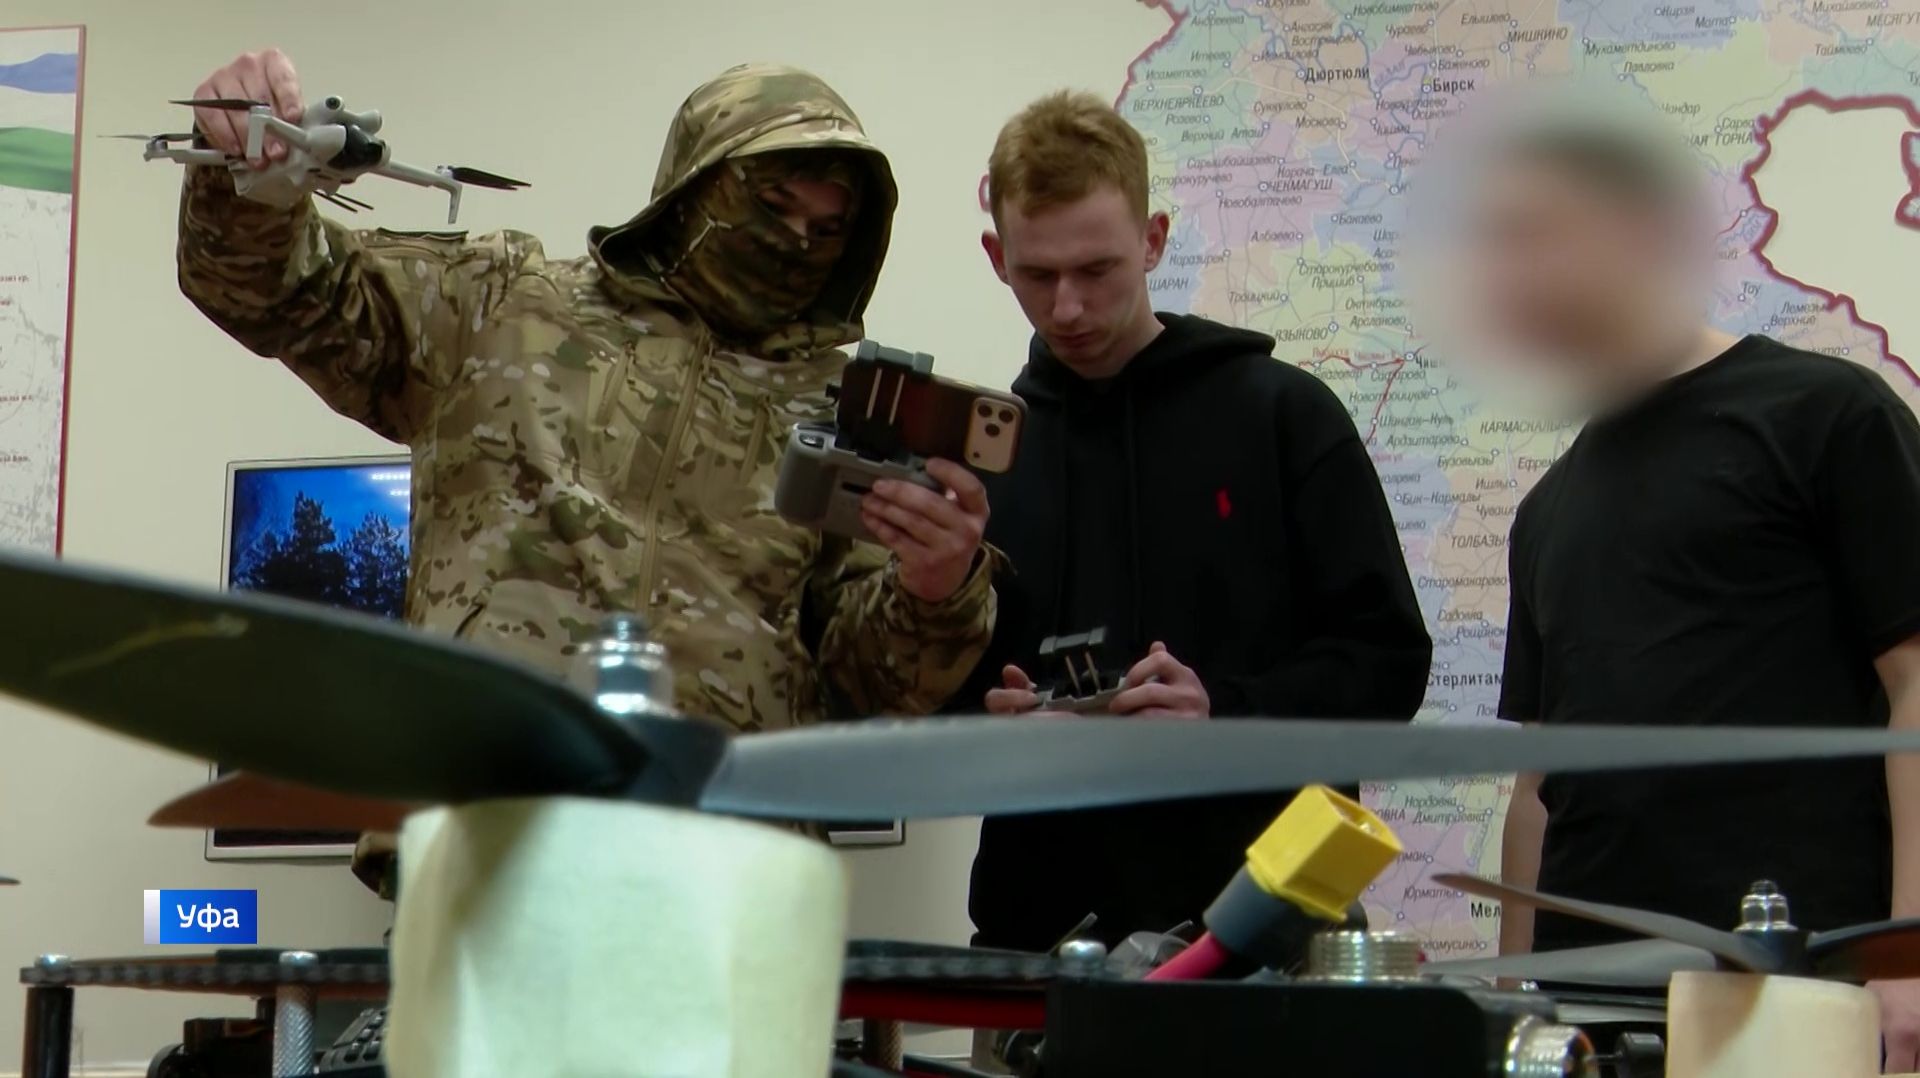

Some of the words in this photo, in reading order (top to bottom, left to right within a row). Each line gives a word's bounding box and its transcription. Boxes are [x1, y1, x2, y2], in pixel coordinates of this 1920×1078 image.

[1695, 16, 1729, 28] Мата
[1507, 27, 1568, 43] МИШКИНО
[1304, 67, 1370, 84] Дюртюли
[1433, 79, 1475, 95] Бирск
[1181, 129, 1225, 143] Верхний
[1268, 178, 1333, 193] ЧЕКМАГУШ
[1149, 279, 1190, 291] ШАРАН
[1311, 276, 1355, 292] Пришиб
[1228, 291, 1280, 305] Троицкий
[1275, 327, 1329, 342] ЯЗЫКОВО
[1476, 477, 1508, 491] Ишлы
[1450, 535, 1506, 549] ТОЛБАЗЫ
[1437, 607, 1483, 621] Садовка
[1403, 885, 1456, 903] Юрматы
